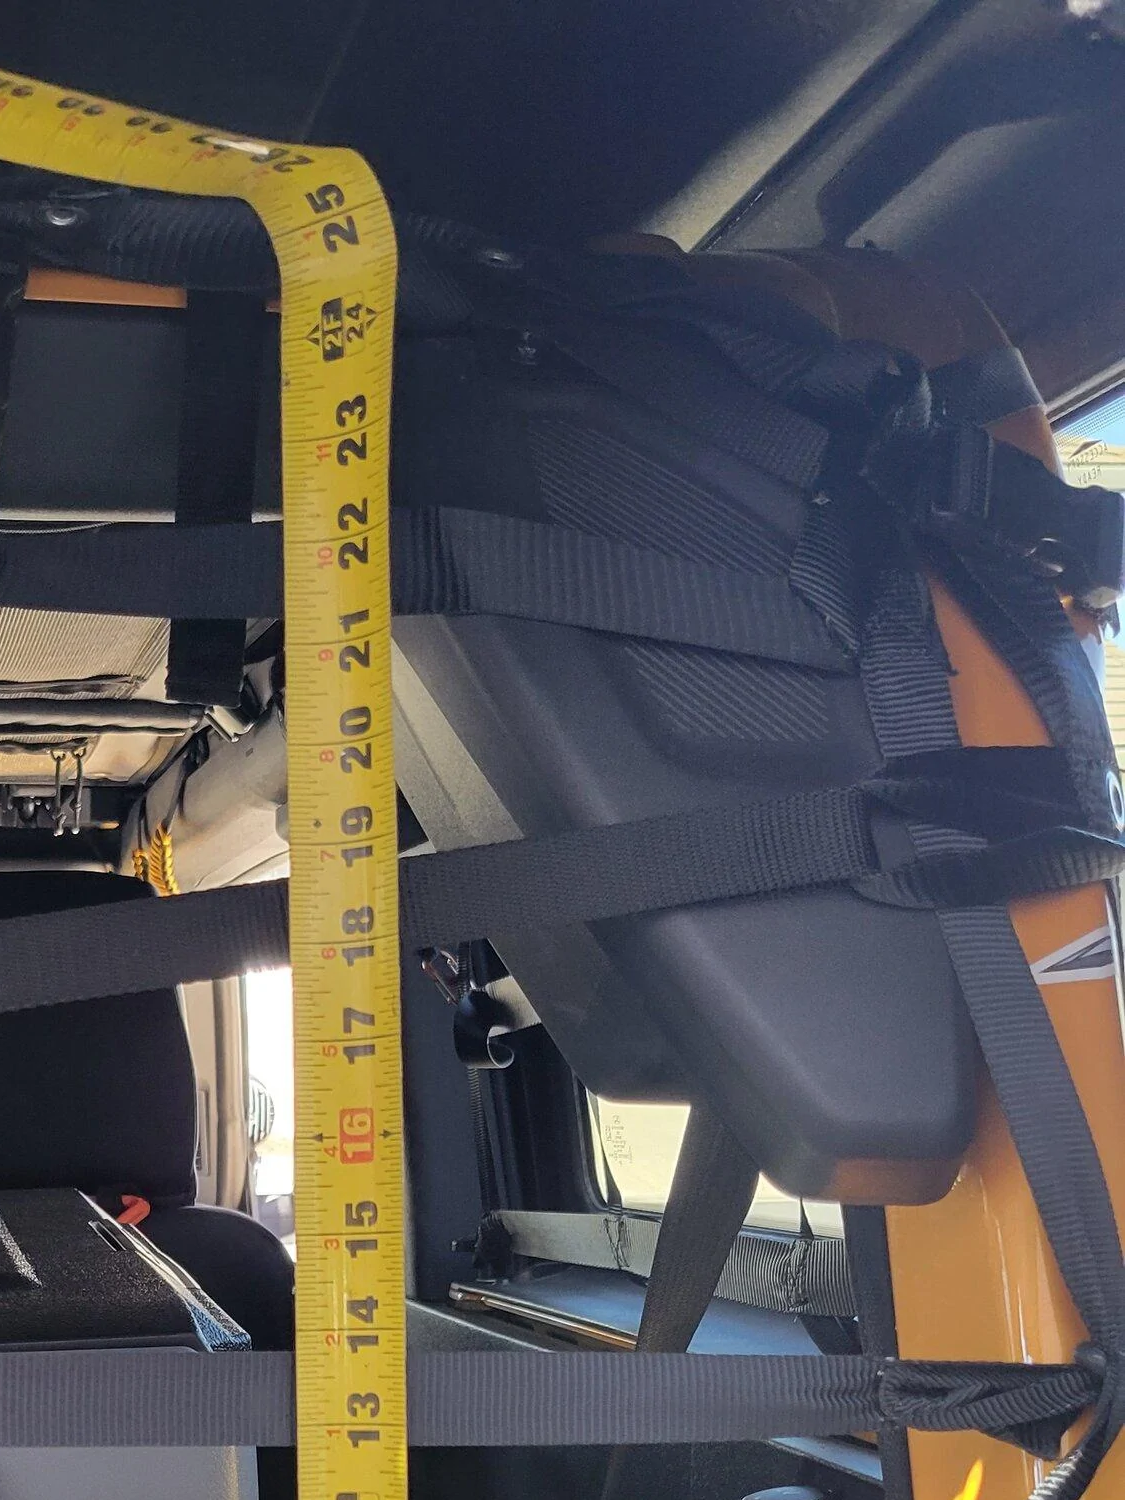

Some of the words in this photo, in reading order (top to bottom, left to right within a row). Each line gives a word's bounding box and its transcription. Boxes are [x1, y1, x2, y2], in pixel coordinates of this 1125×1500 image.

[305, 182, 361, 255] 25
[345, 303, 365, 345] 24
[336, 394, 368, 467] 23
[338, 497, 369, 570] 22
[338, 609, 370, 673] 21
[339, 706, 372, 774] 20
[340, 805, 373, 867] 19
[341, 905, 375, 967] 18
[342, 1006, 376, 1065] 17
[342, 1110, 373, 1162] 16
[345, 1200, 378, 1259] 15
[346, 1295, 379, 1354] 14
[347, 1392, 380, 1448] 13
